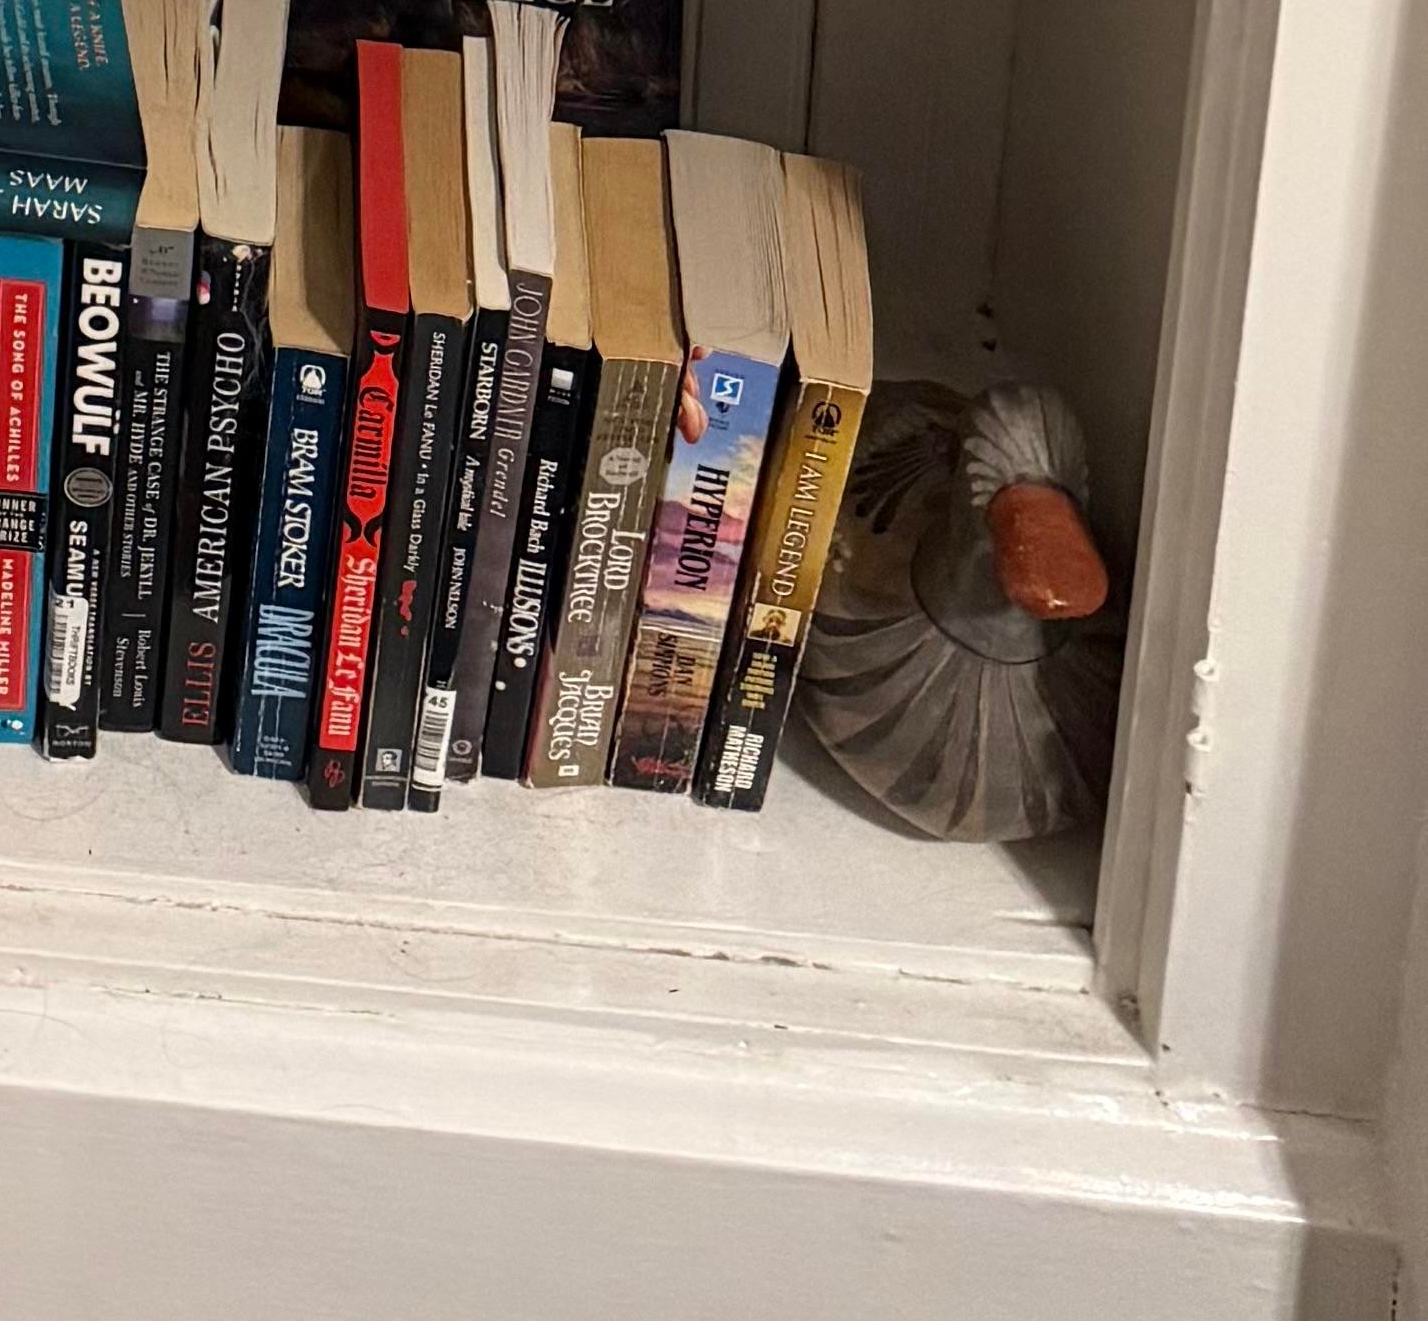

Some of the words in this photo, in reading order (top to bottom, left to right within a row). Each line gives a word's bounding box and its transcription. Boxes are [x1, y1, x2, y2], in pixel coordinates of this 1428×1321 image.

[12, 330, 26, 373] SONG
[208, 331, 247, 458] PSYCHO
[6, 407, 22, 483] ACHILLES
[489, 447, 514, 519] Grendel
[535, 458, 558, 517] Richard
[191, 467, 234, 623] AMERICAN
[678, 462, 731, 594] HYPERION
